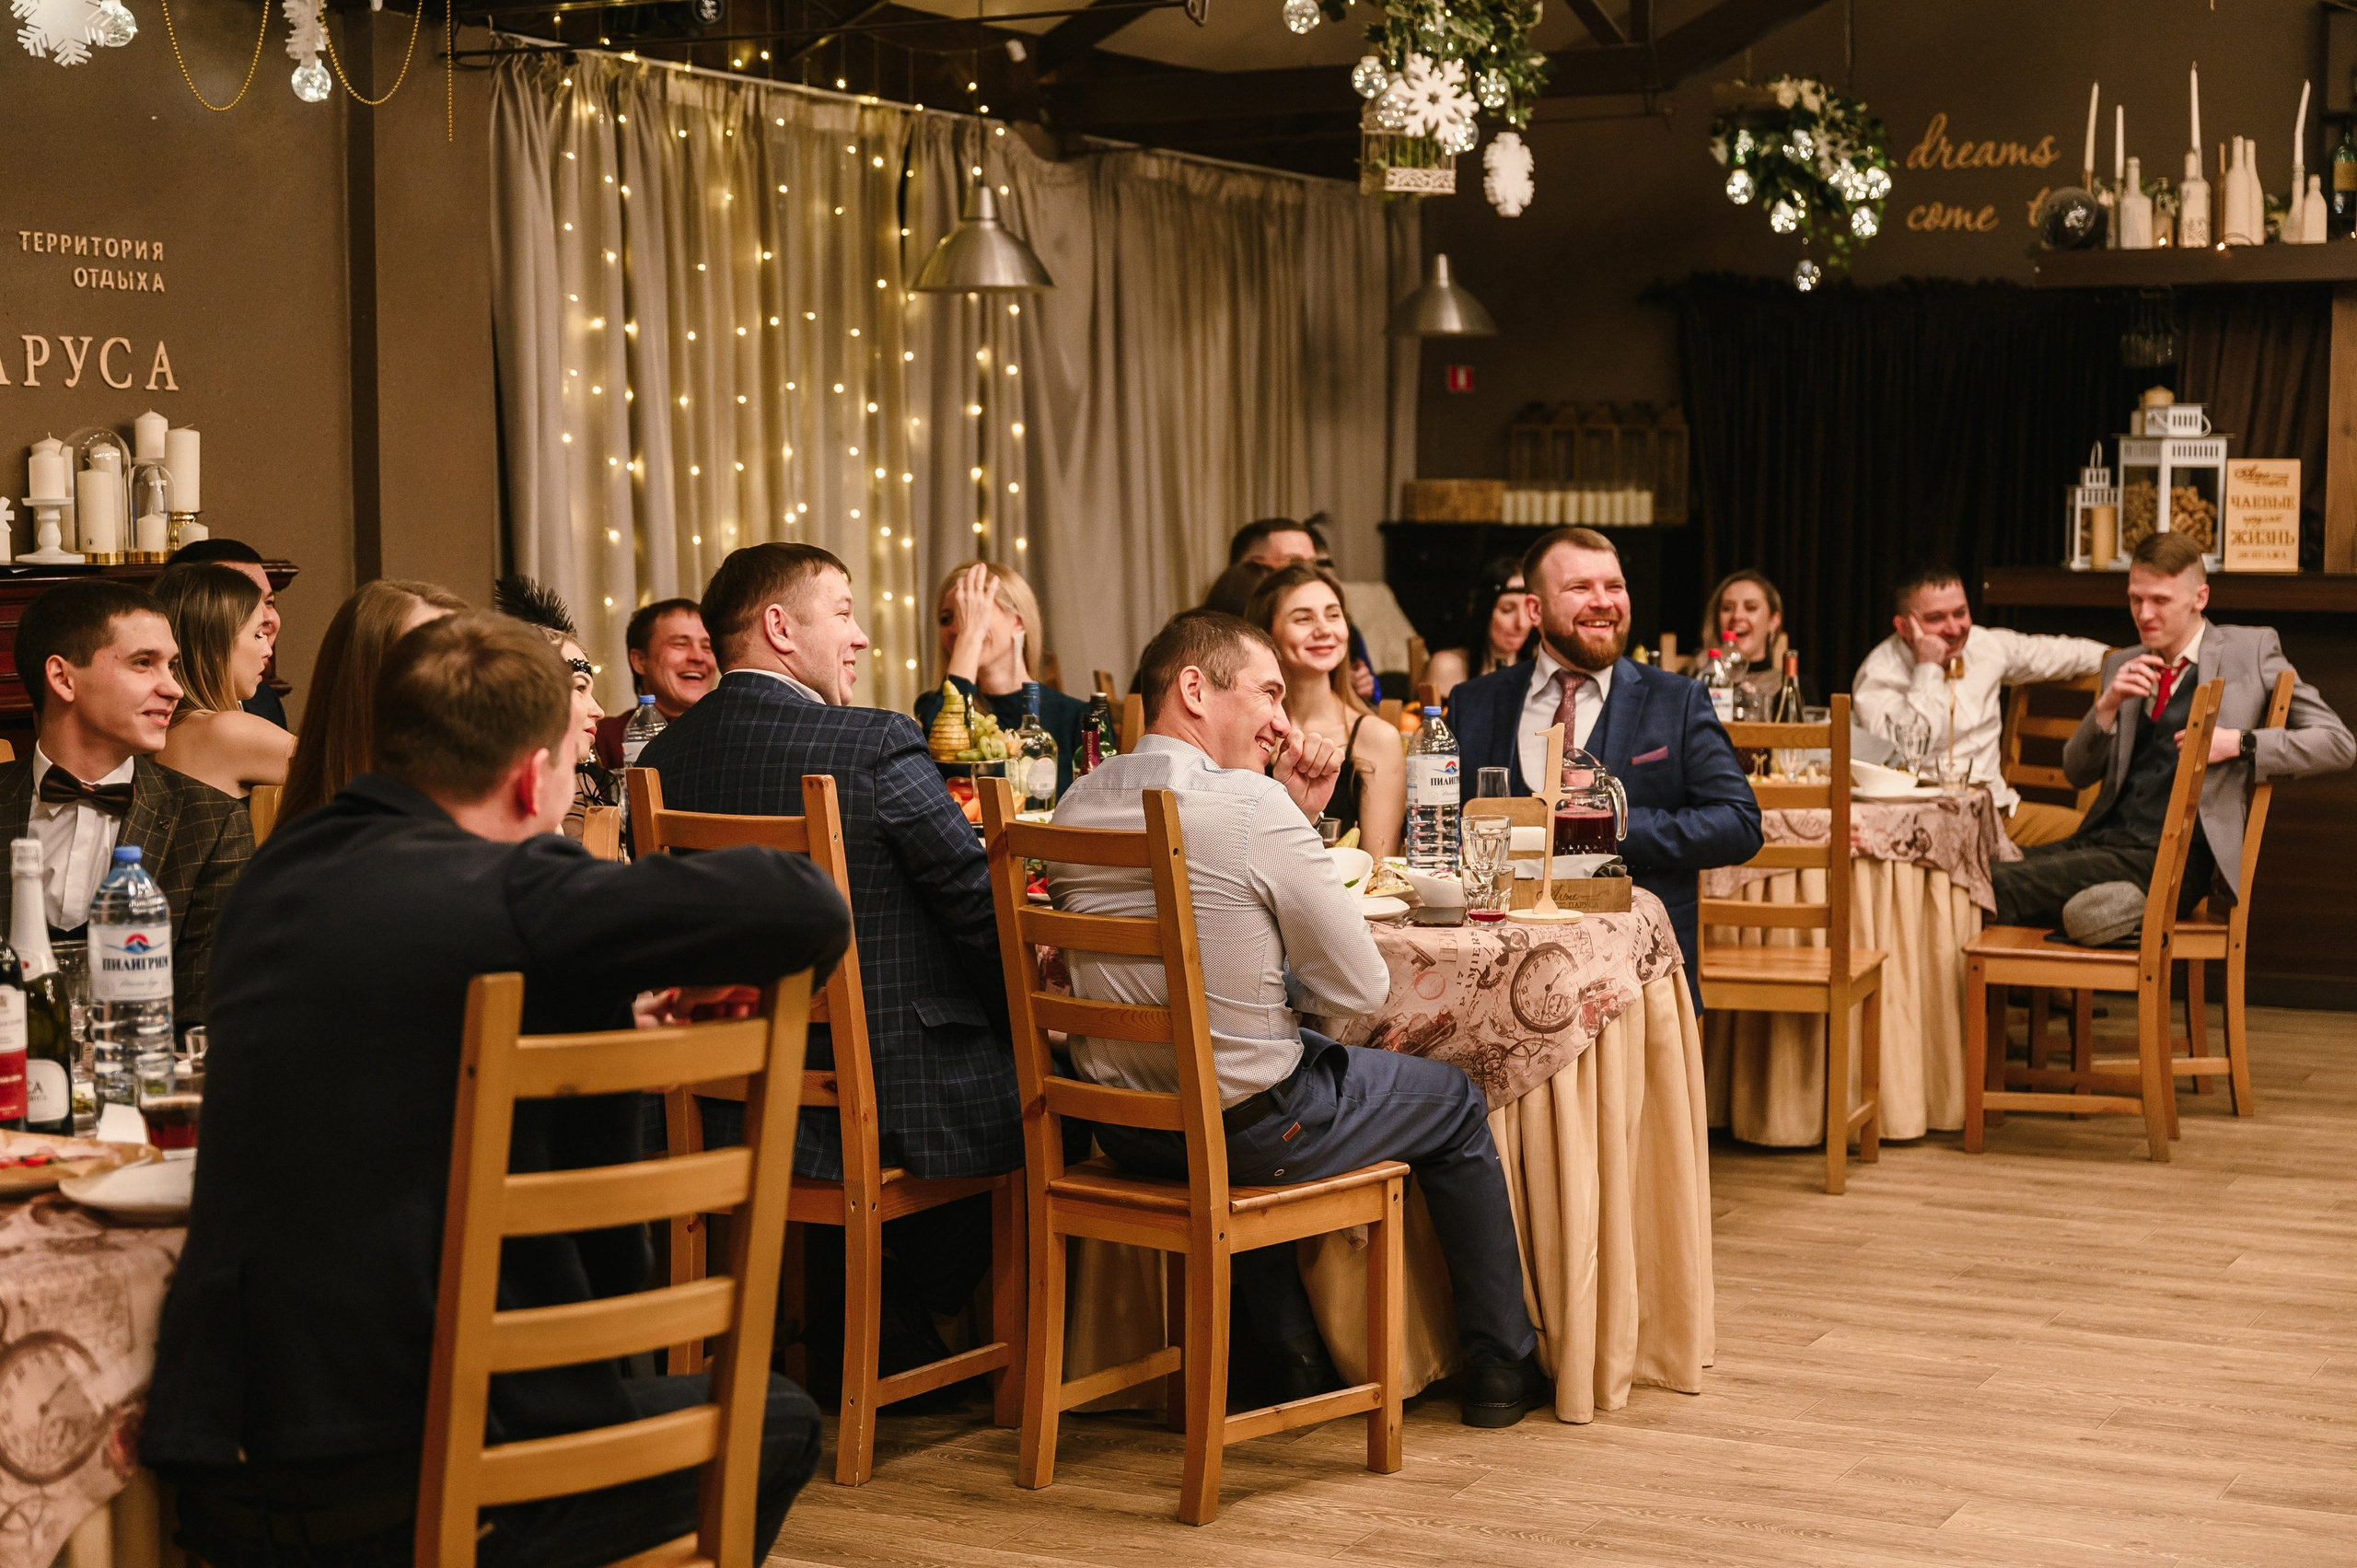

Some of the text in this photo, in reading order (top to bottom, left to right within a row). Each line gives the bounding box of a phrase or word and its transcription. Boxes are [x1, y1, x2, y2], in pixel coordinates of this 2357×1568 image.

[1906, 112, 2061, 169] dreams
[1906, 201, 1999, 230] come
[18, 230, 164, 261] ТЕРРИТОРИЯ
[74, 267, 165, 293] ОТДЫХА
[2230, 494, 2295, 510] ЧАЕВЫЕ
[2230, 528, 2295, 546] ЖИЗНЬ
[102, 957, 168, 971] ПИЛИГРИМ
